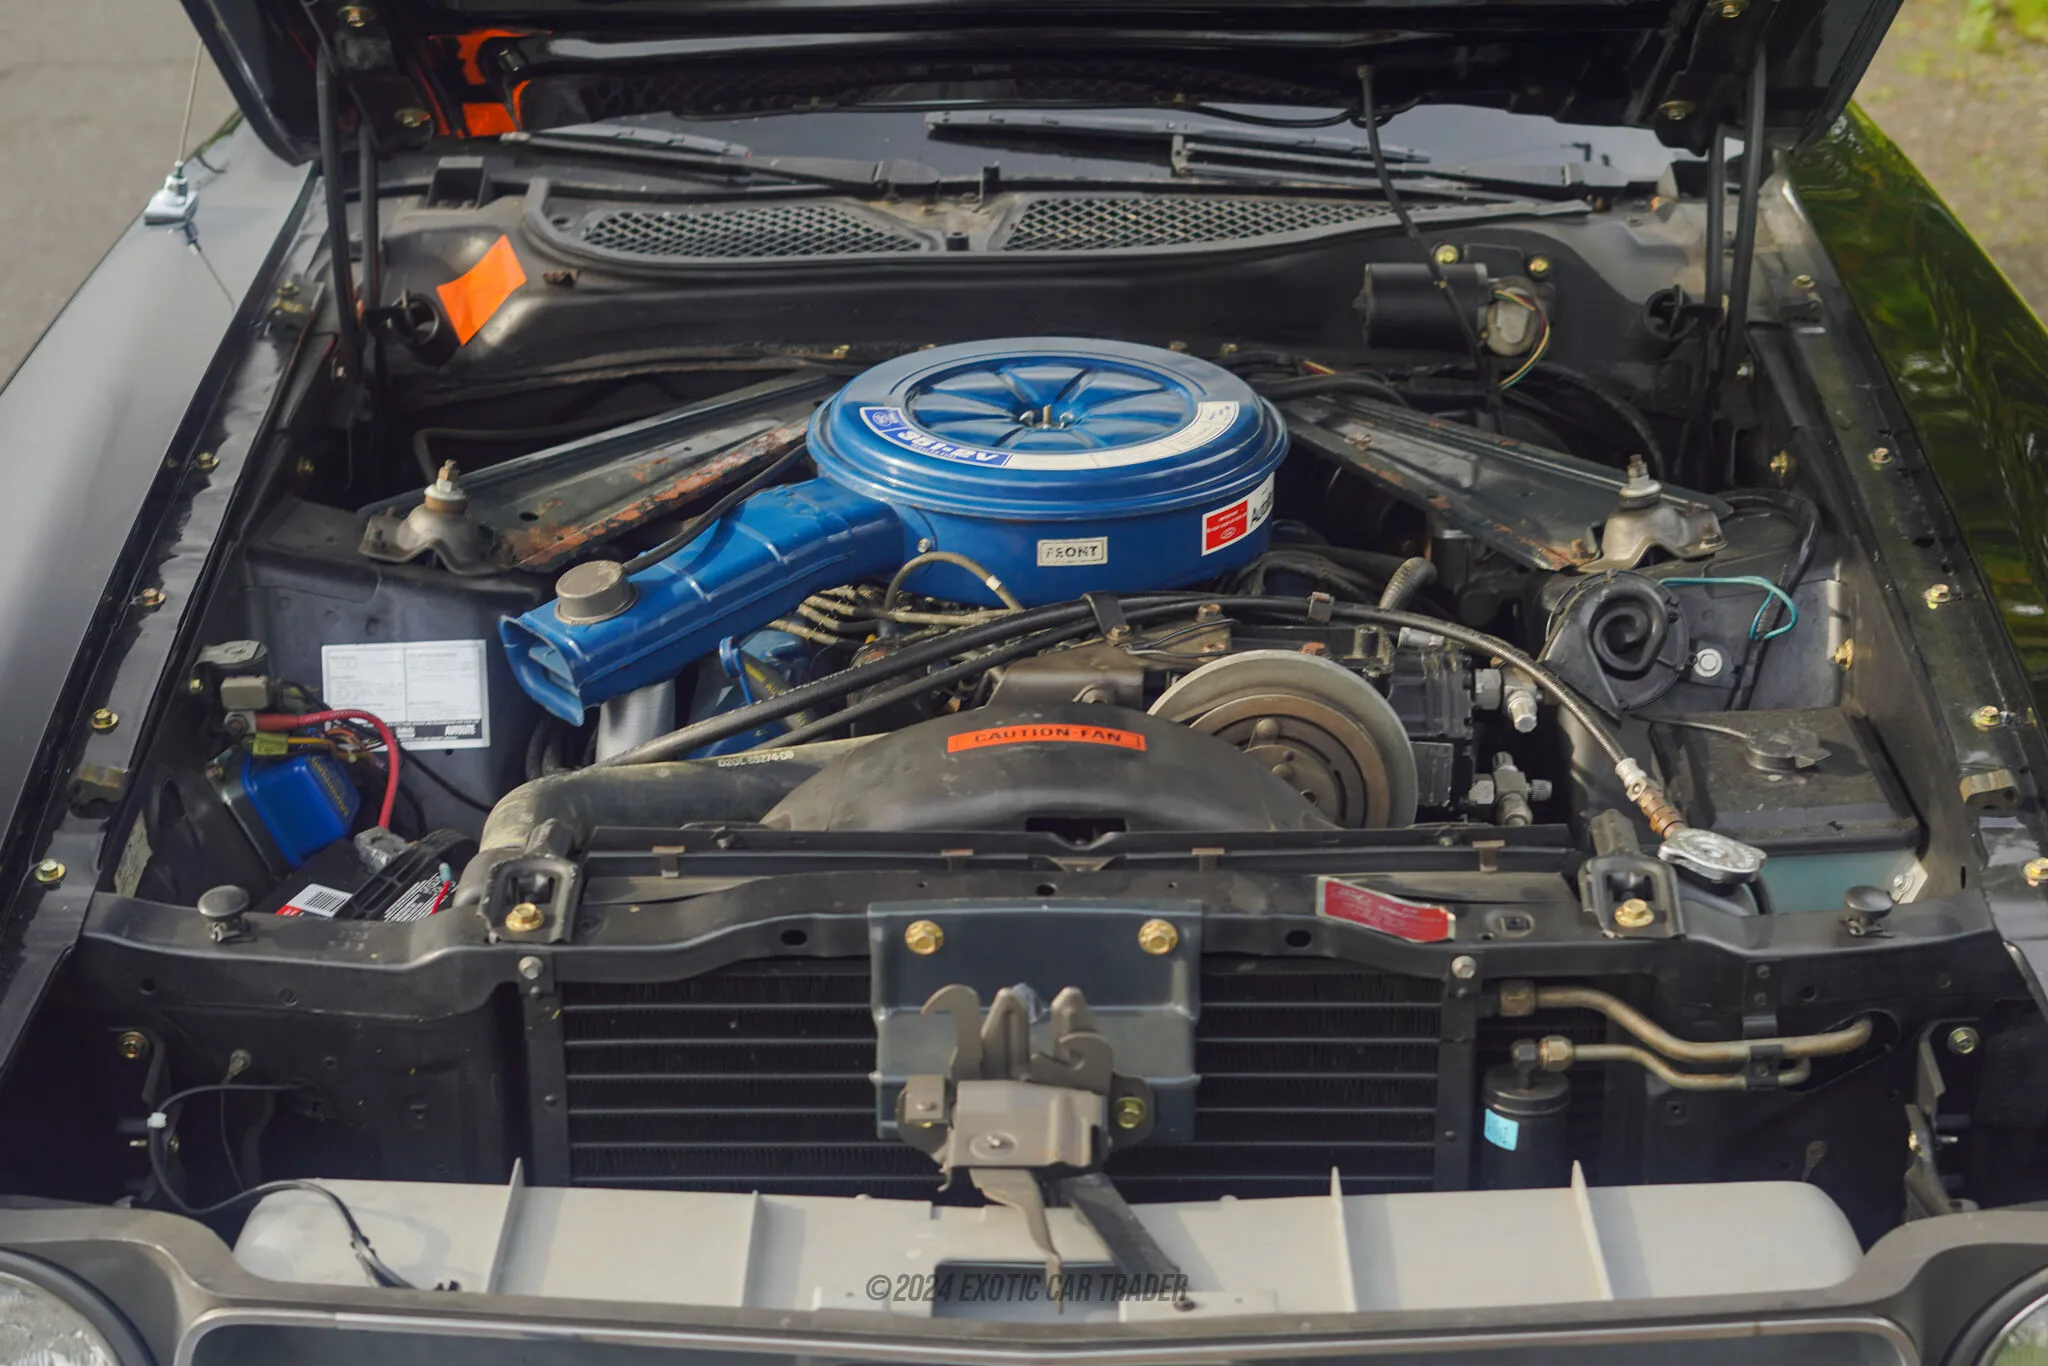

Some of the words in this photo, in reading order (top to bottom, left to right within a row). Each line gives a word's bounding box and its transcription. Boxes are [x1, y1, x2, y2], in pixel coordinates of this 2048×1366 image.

[445, 724, 477, 736] AUTOLITE
[975, 728, 1070, 742] CAUTION
[1080, 729, 1122, 743] FAN
